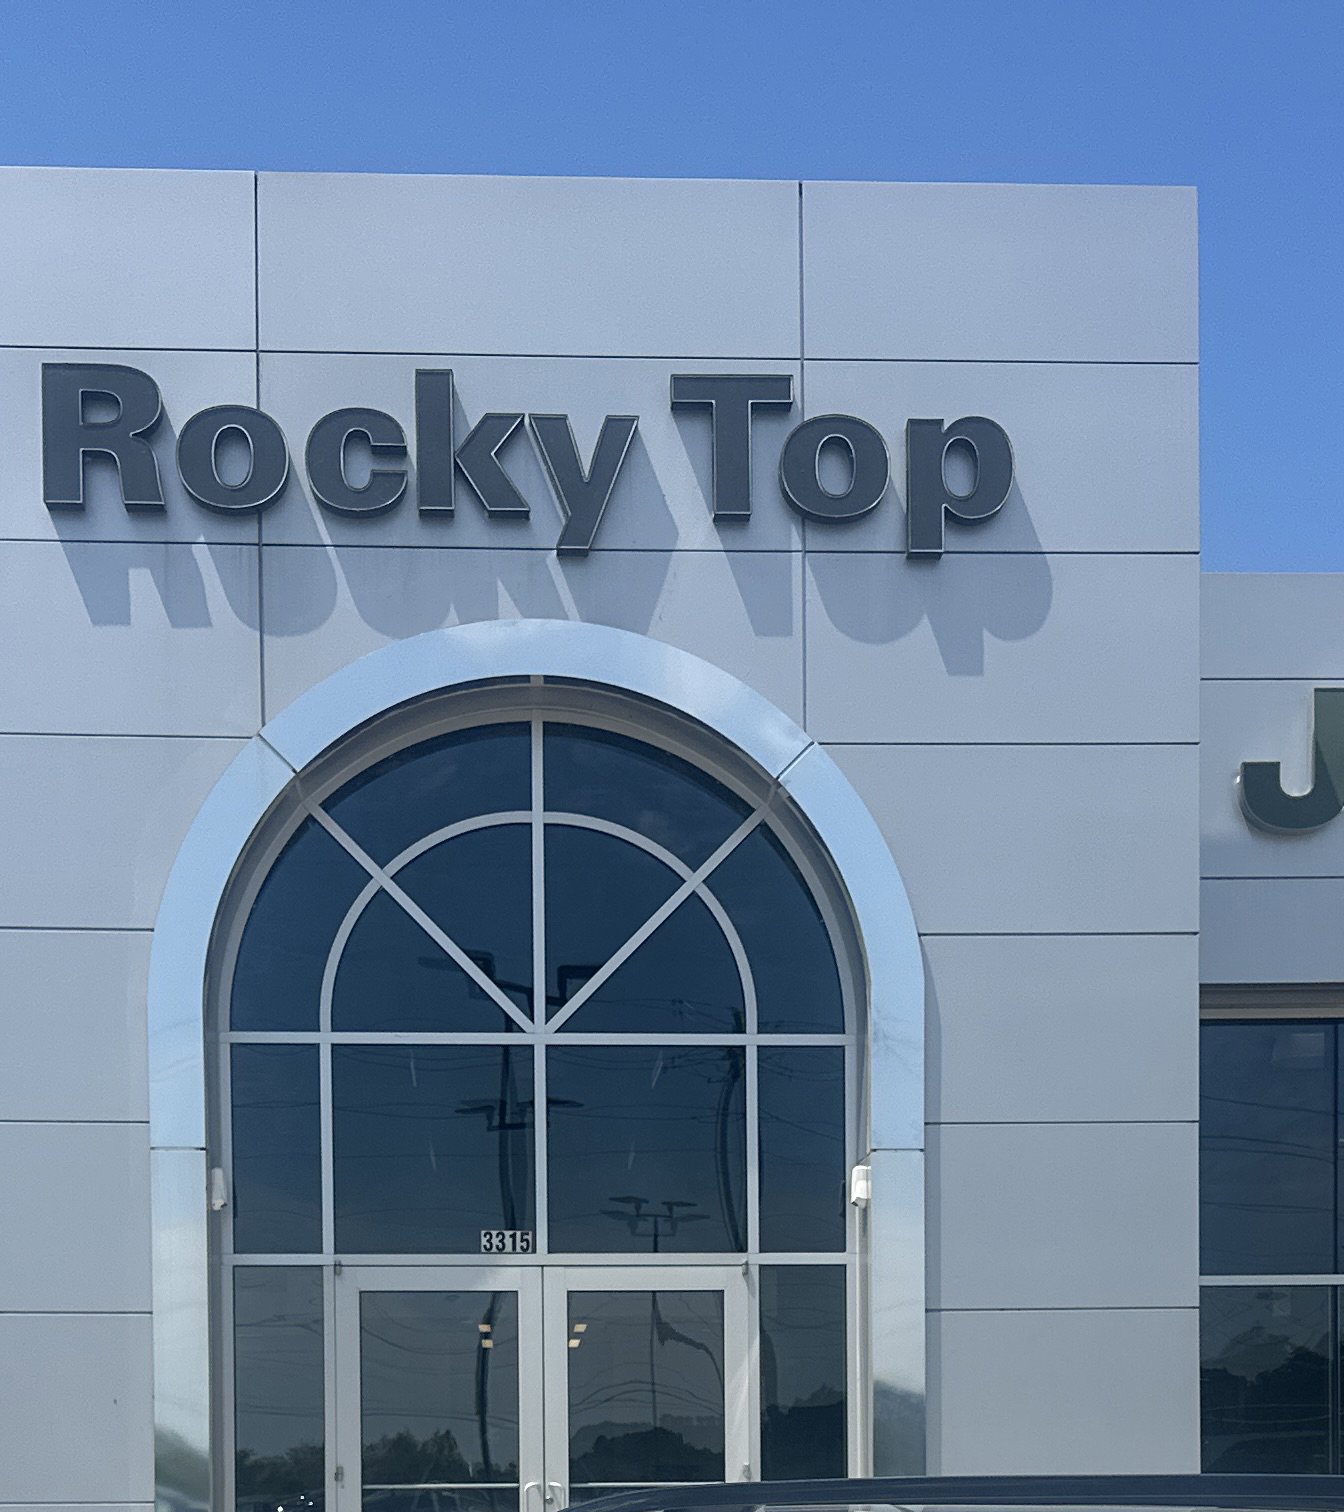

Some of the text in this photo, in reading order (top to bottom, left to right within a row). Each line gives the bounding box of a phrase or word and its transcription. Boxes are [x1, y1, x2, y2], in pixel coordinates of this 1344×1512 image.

[41, 363, 1015, 559] Rocky Top
[483, 1231, 530, 1252] 3315
